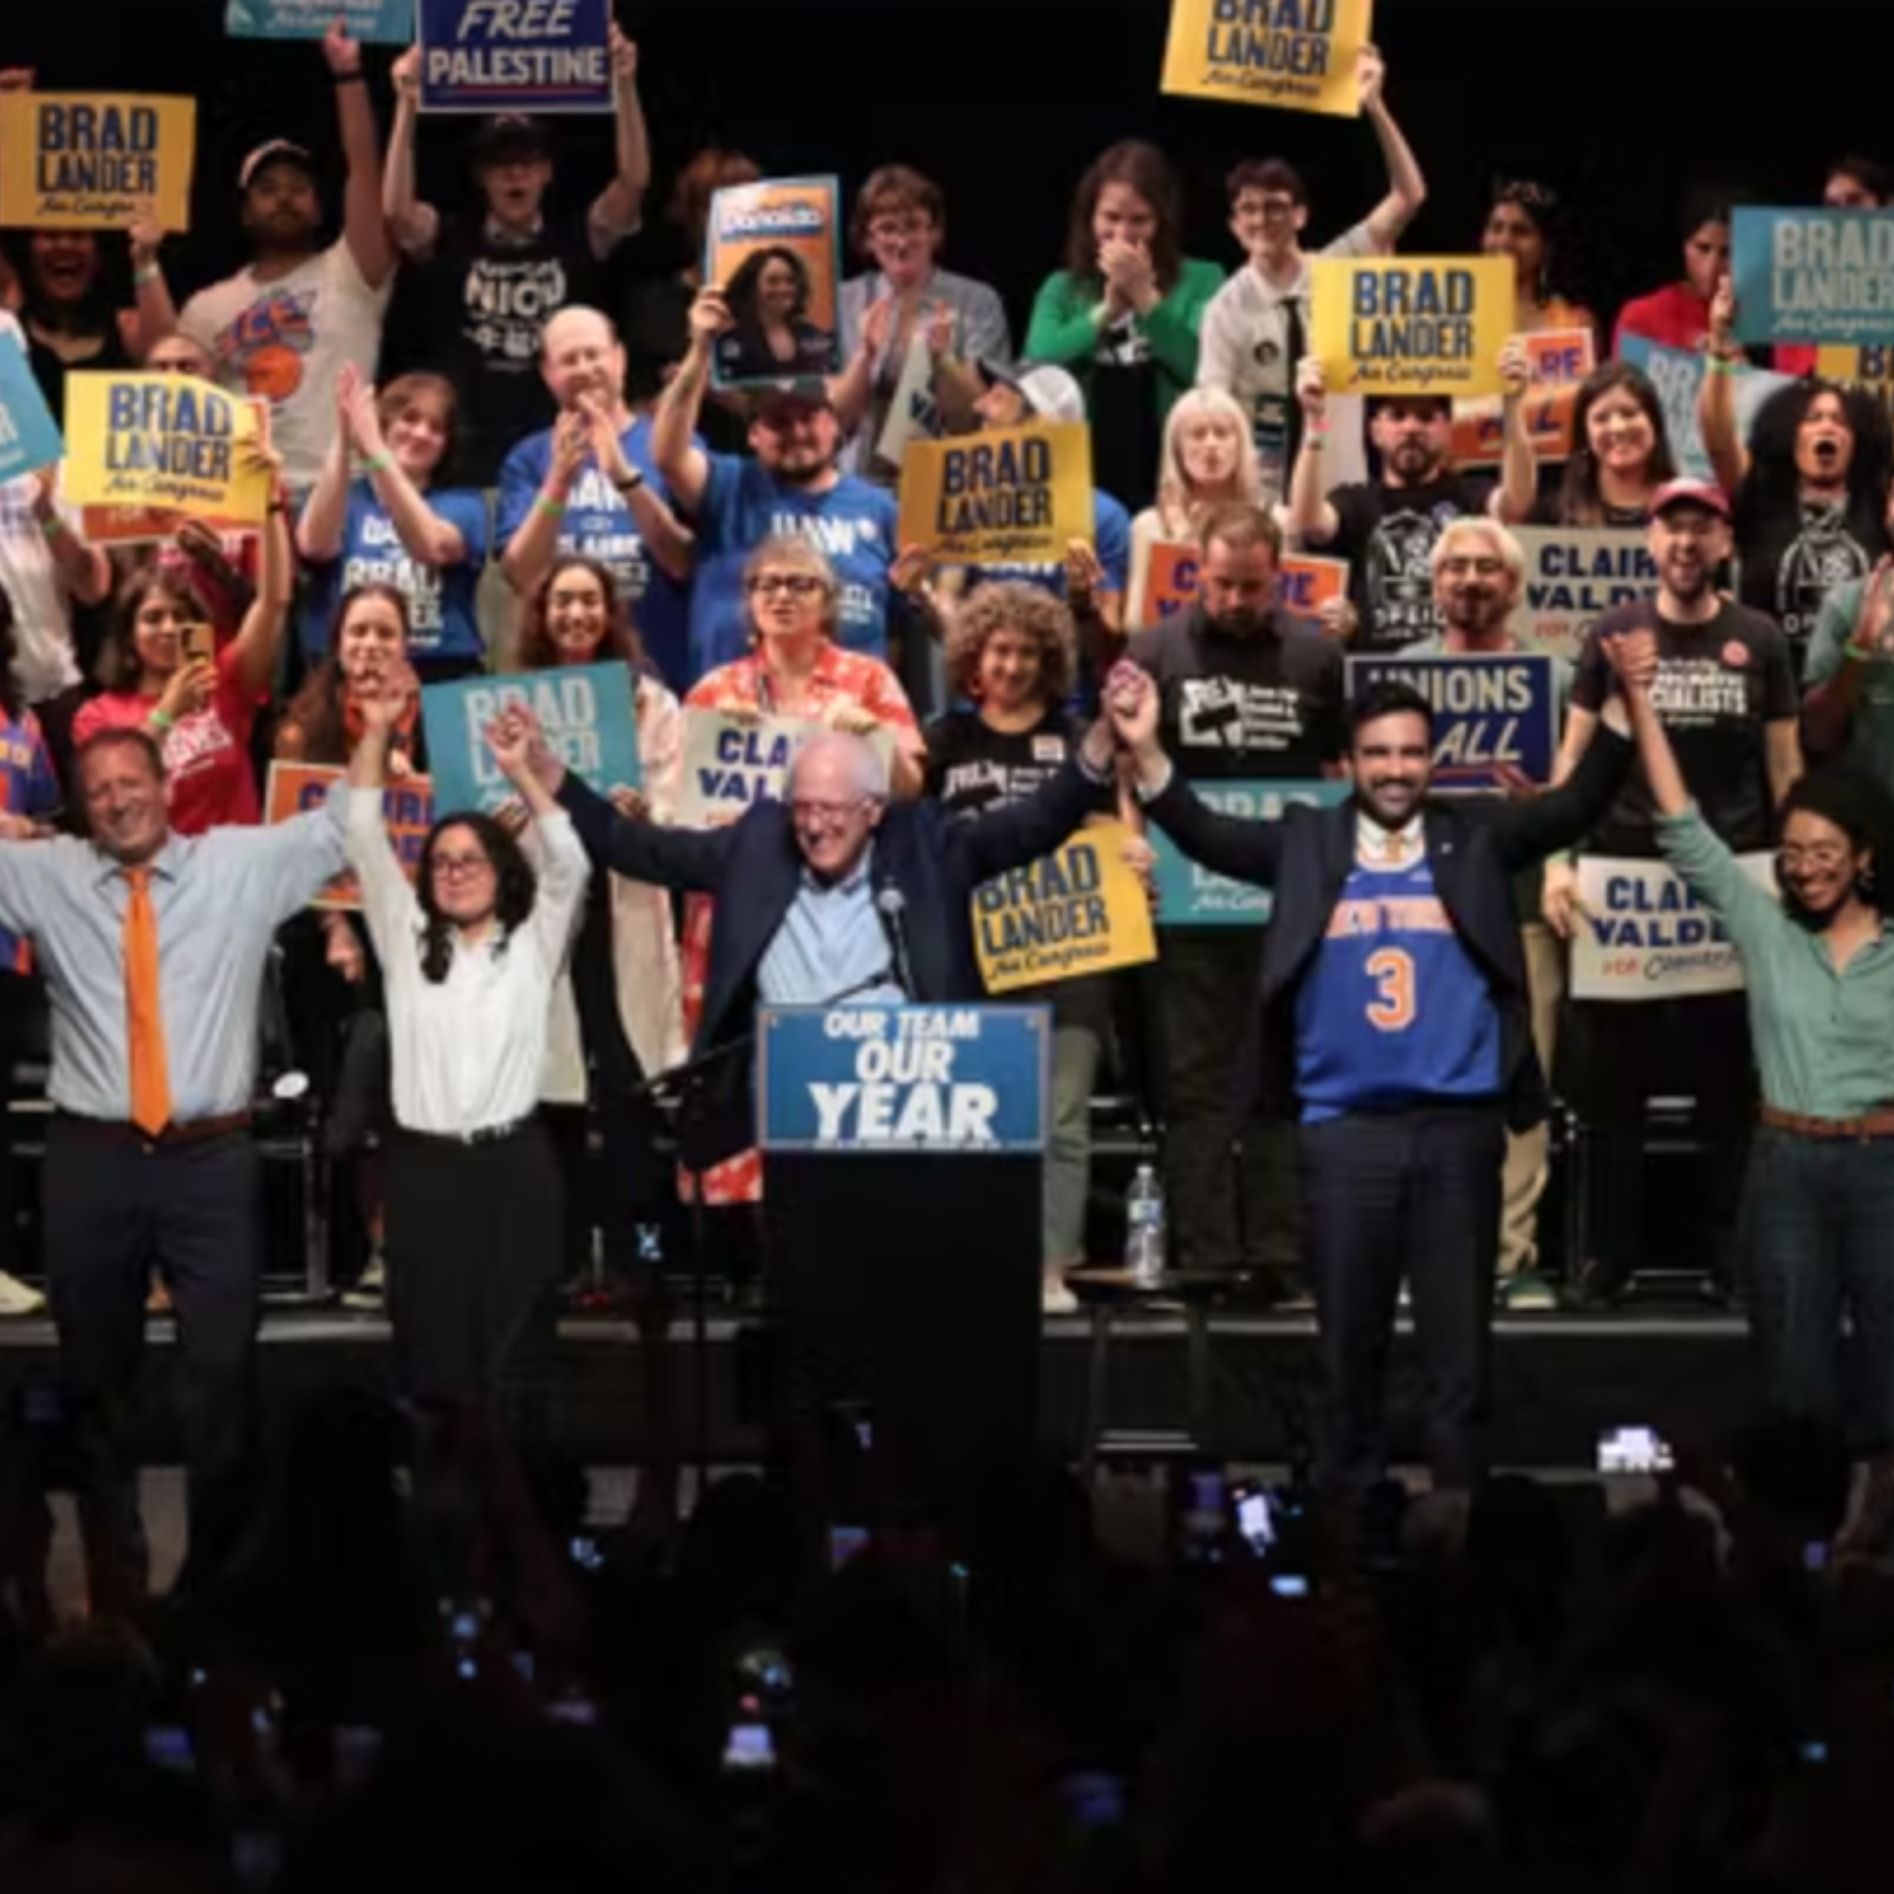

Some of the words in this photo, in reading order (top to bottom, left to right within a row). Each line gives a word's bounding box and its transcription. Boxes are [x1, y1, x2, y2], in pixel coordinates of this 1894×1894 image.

[456, 0, 577, 39] FREE
[427, 47, 608, 84] PALESTINE
[1207, 24, 1329, 76] LANDER
[38, 104, 159, 152] BRAD
[38, 152, 157, 194] LANDER
[1772, 217, 1894, 268] BRAD
[1353, 269, 1475, 316] BRAD
[1352, 317, 1475, 361] LANDER
[109, 382, 232, 437] BRAD
[105, 432, 230, 483] LANDER
[944, 437, 1051, 496] BRAD
[935, 487, 1053, 535] LANDER
[1539, 543, 1660, 579] CLAIR
[1526, 581, 1658, 611] VALD
[1366, 666, 1534, 713] NIONS
[1430, 717, 1521, 765] ALL
[697, 767, 778, 801] VAL
[978, 844, 1099, 912] BRAD
[1606, 874, 1701, 913] CLAI
[981, 894, 1111, 955] LANDER
[1364, 946, 1416, 1033] 3
[822, 1009, 887, 1040] OUR
[896, 1009, 982, 1040] TEAM
[855, 1039, 955, 1084] OUR
[807, 1081, 998, 1149] YEAR
